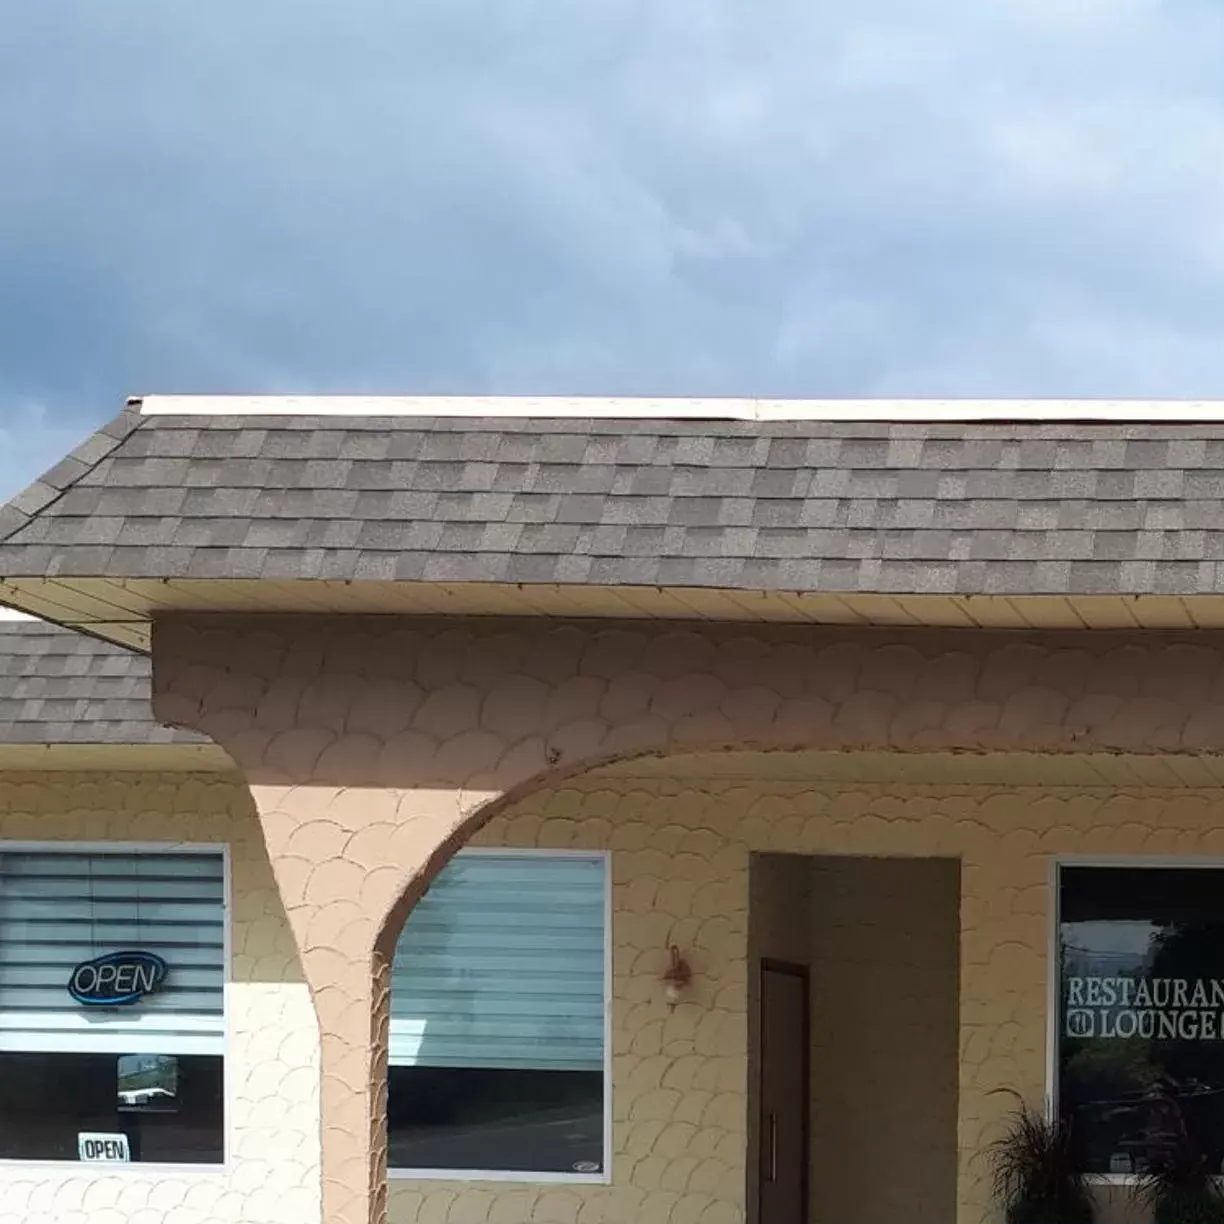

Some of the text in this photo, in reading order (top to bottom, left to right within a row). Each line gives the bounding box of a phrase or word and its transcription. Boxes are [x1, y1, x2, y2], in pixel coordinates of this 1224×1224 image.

[74, 965, 155, 992] OPEN
[1101, 1009, 1216, 1039] LOUNGE
[84, 1140, 125, 1159] OPEN
